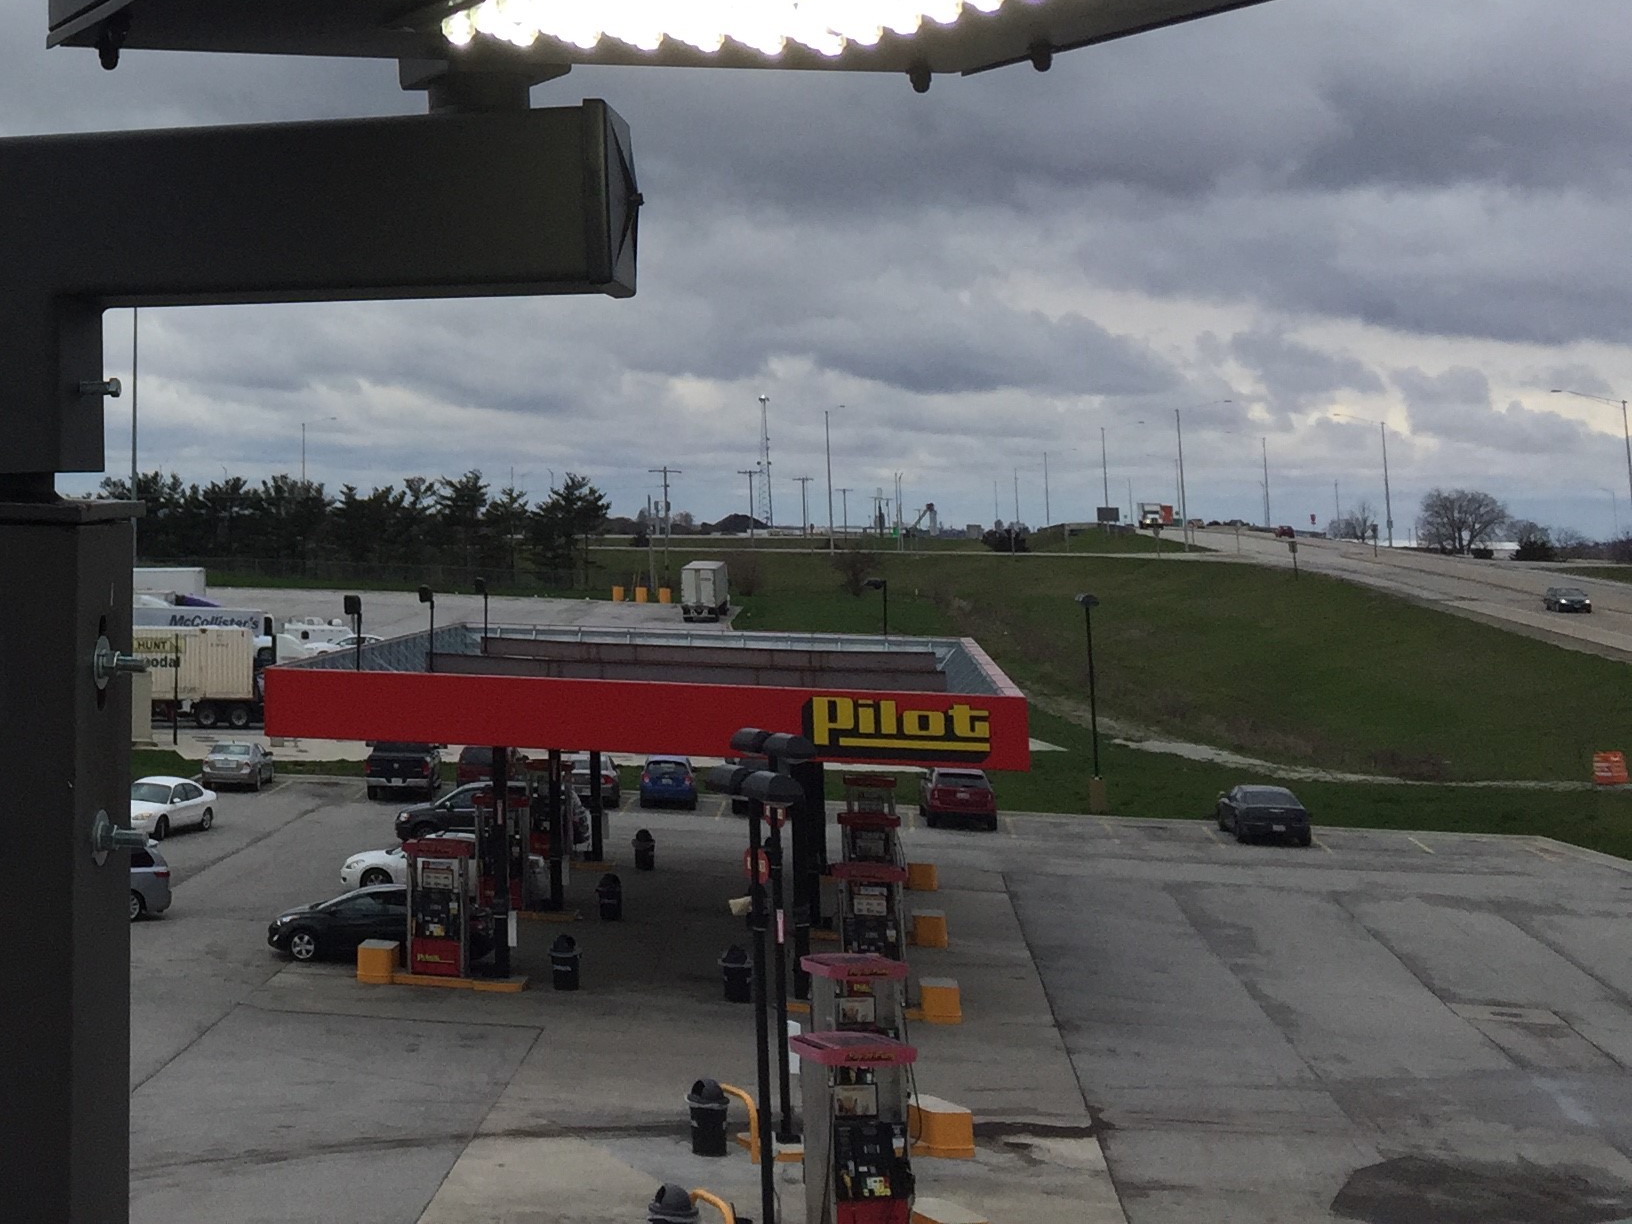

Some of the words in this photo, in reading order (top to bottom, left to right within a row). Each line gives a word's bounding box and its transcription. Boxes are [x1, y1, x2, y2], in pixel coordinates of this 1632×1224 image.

[169, 614, 259, 629] McCollister's
[137, 640, 167, 651] HUNT
[812, 696, 990, 746] Pilot
